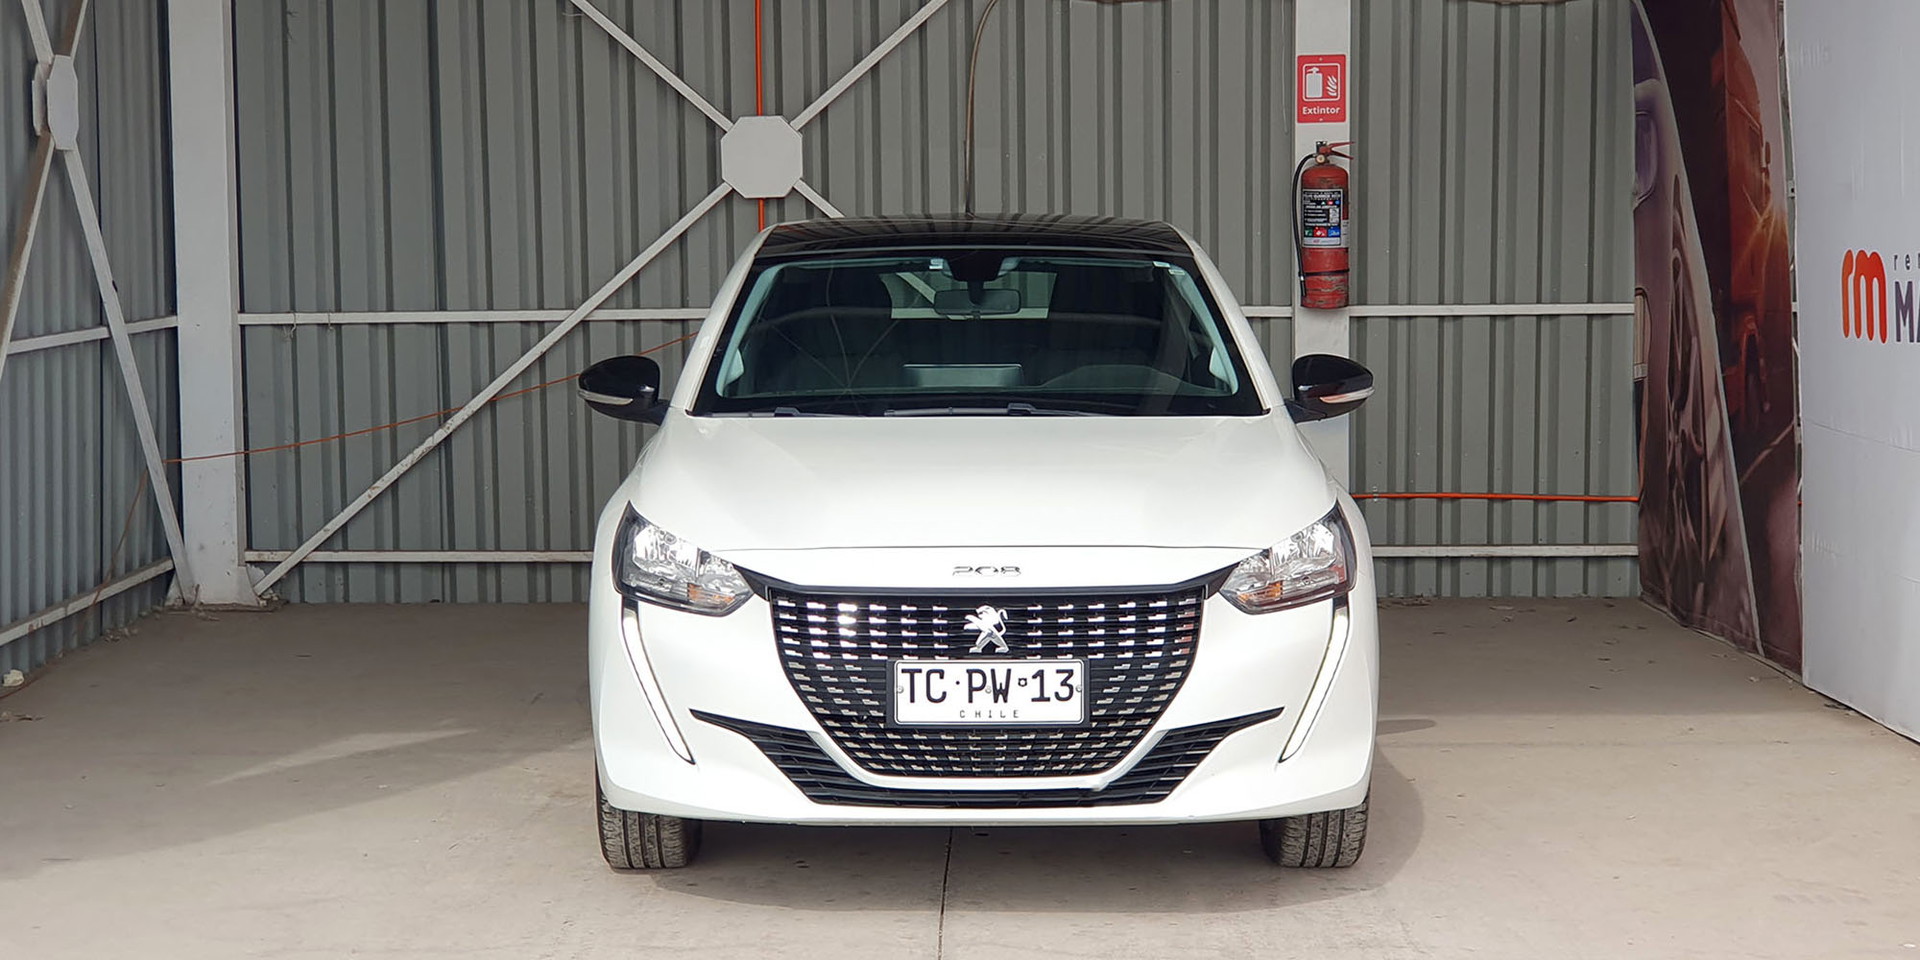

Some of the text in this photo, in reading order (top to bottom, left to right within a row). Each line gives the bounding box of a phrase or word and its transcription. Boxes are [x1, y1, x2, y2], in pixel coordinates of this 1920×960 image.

[1302, 105, 1341, 115] Extintor
[1894, 280, 1920, 343] M
[952, 566, 1021, 576] 208
[959, 709, 1019, 719] CHILE
